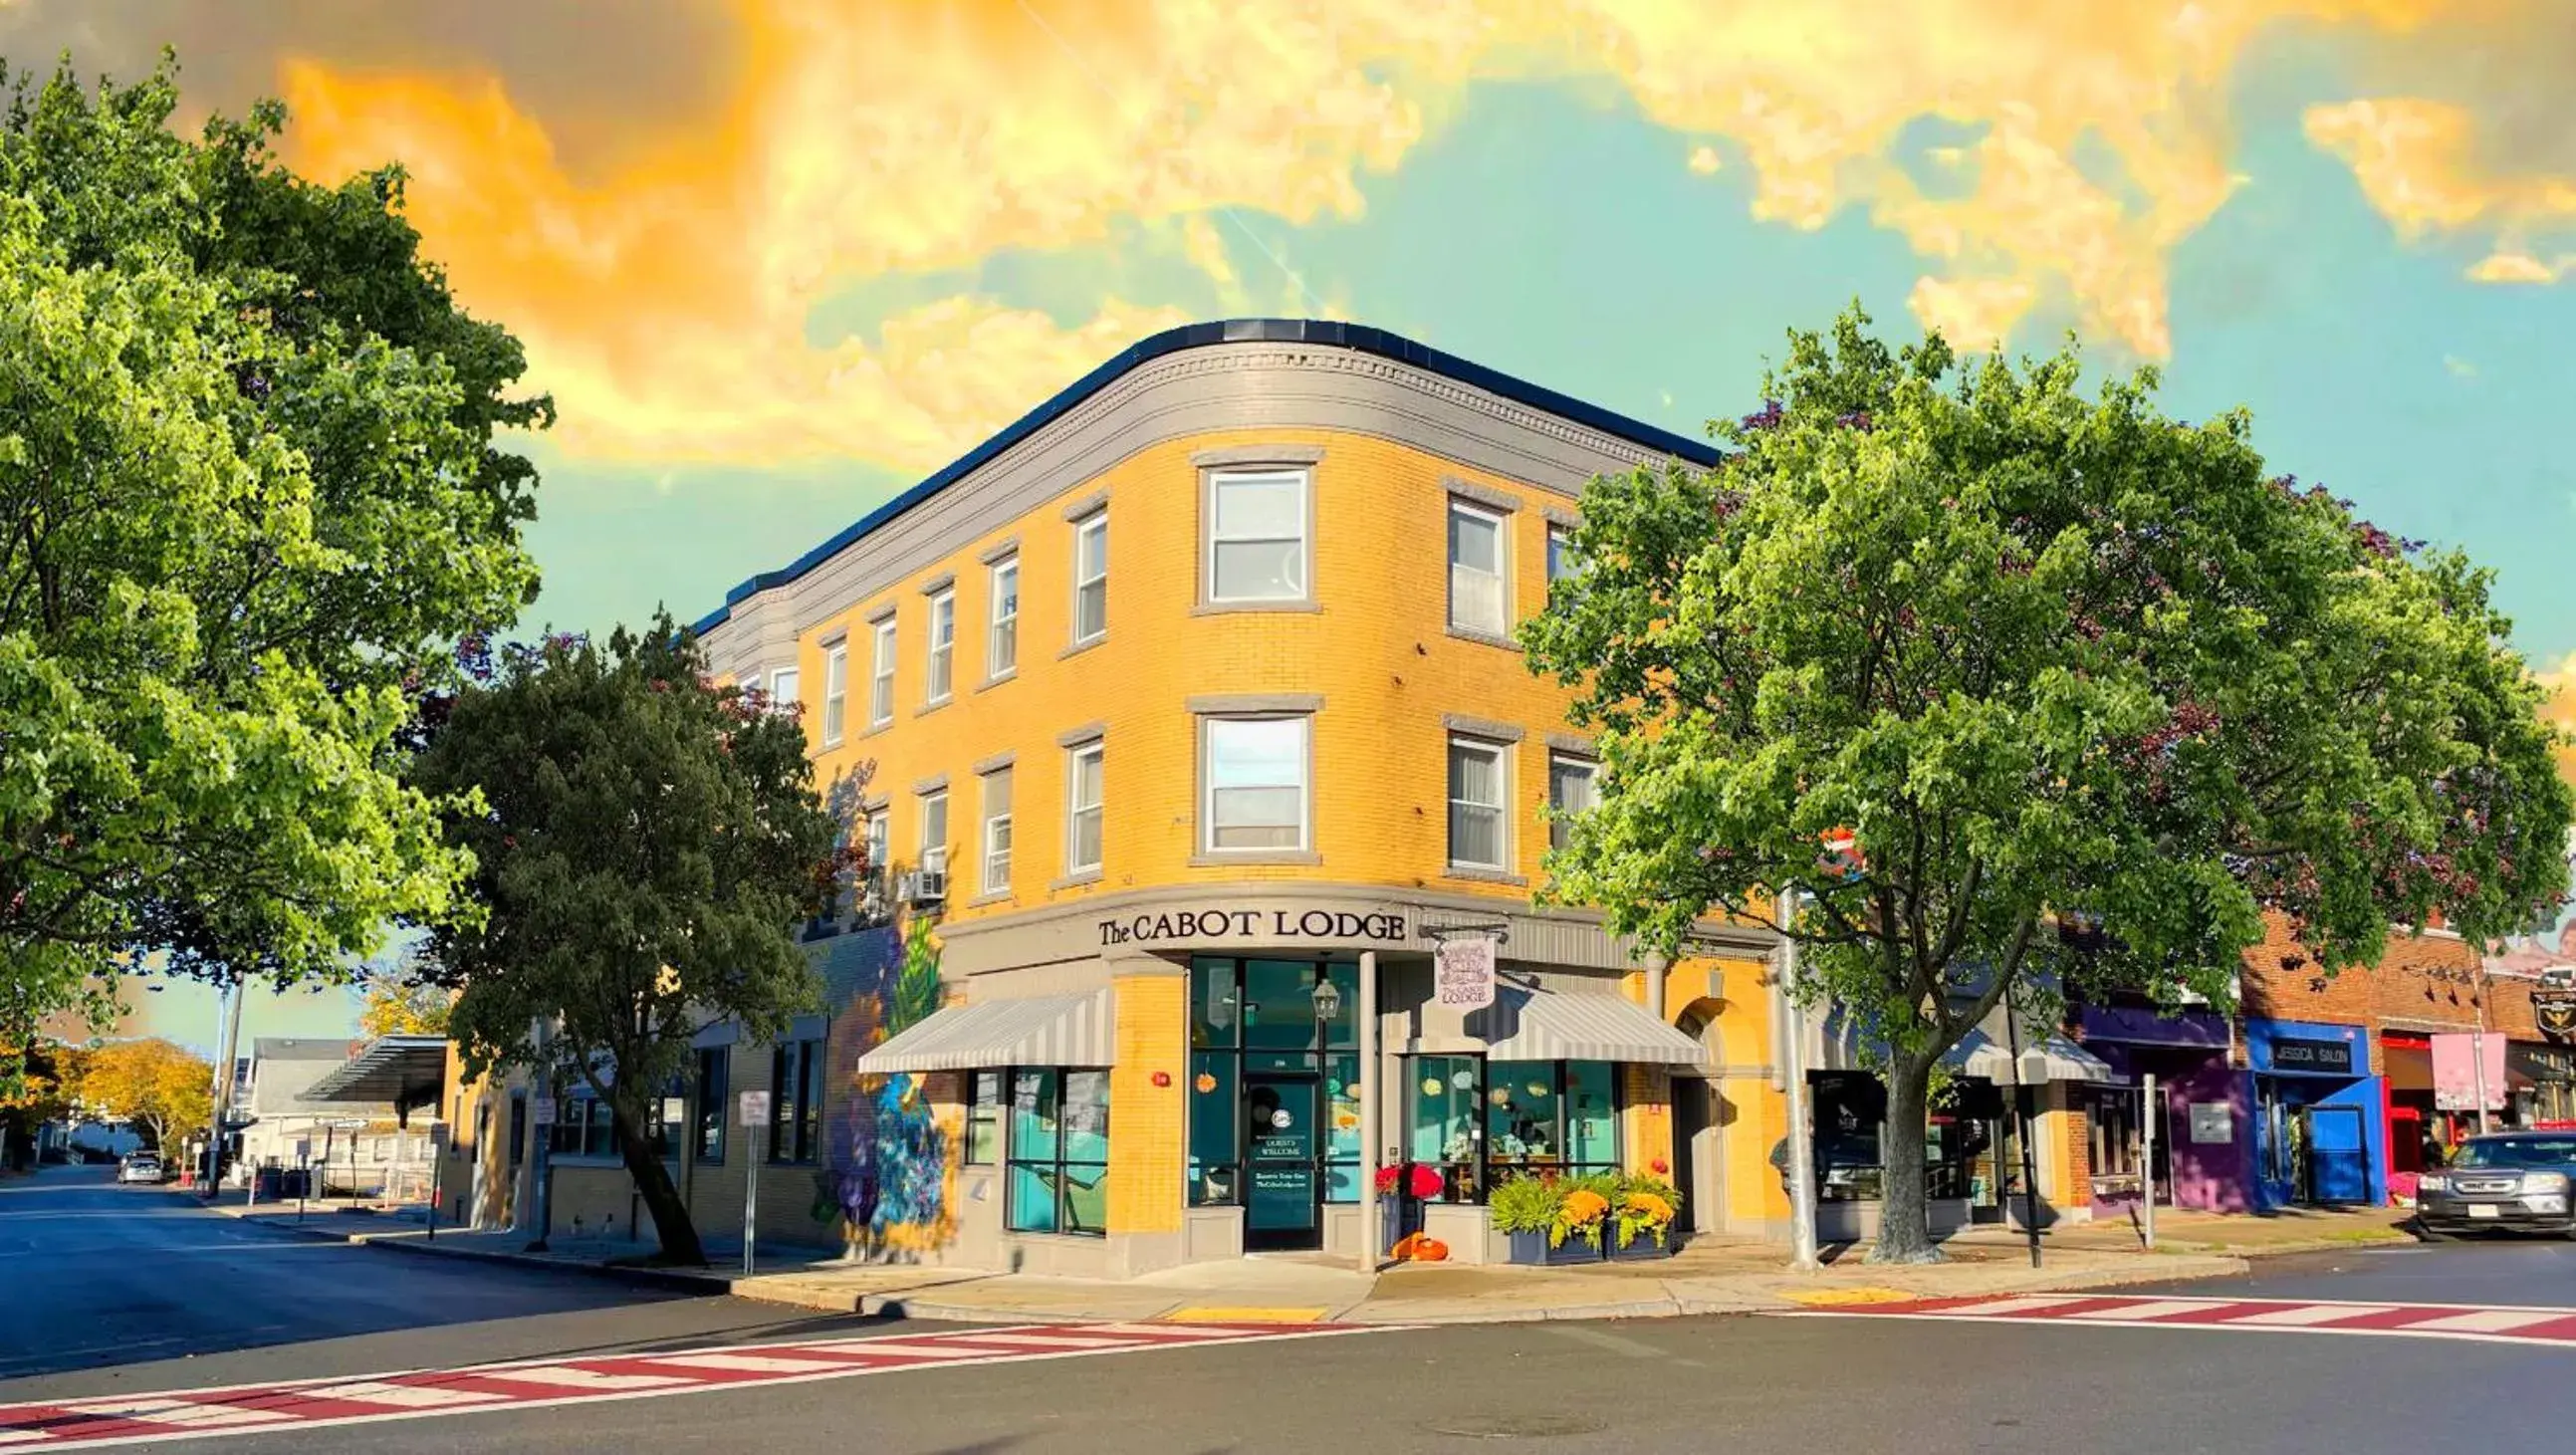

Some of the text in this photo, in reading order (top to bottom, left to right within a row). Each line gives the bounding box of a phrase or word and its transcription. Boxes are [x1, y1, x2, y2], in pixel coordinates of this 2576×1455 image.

[1099, 910, 1406, 946] The CABOT LODGE
[2276, 1046, 2349, 1064] JESSICA SALON
